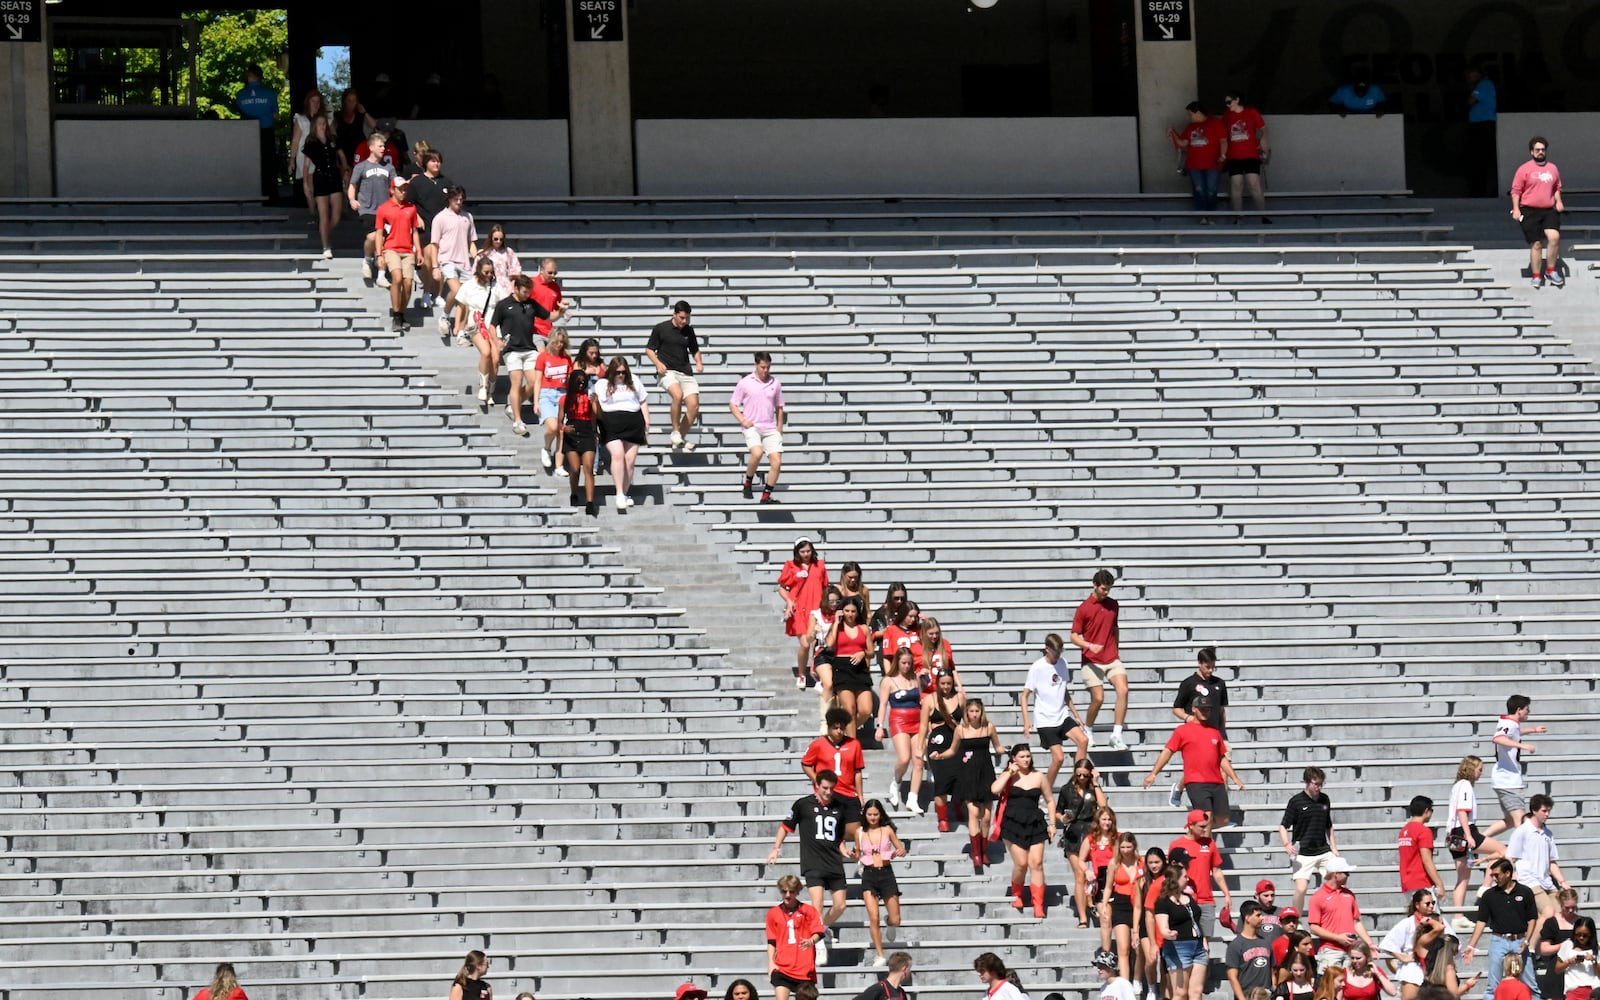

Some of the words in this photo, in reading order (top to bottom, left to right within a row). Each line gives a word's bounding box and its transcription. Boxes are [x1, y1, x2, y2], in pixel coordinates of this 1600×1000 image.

[0, 1, 32, 10] SEATS
[580, 1, 615, 10] SEATS
[1149, 1, 1183, 11] SEATS
[3, 14, 30, 23] 16-29
[588, 14, 608, 23] 1-15
[1153, 14, 1180, 23] 16-29
[834, 752, 842, 776] 1
[815, 815, 837, 841] 19
[786, 919, 797, 944] 1
